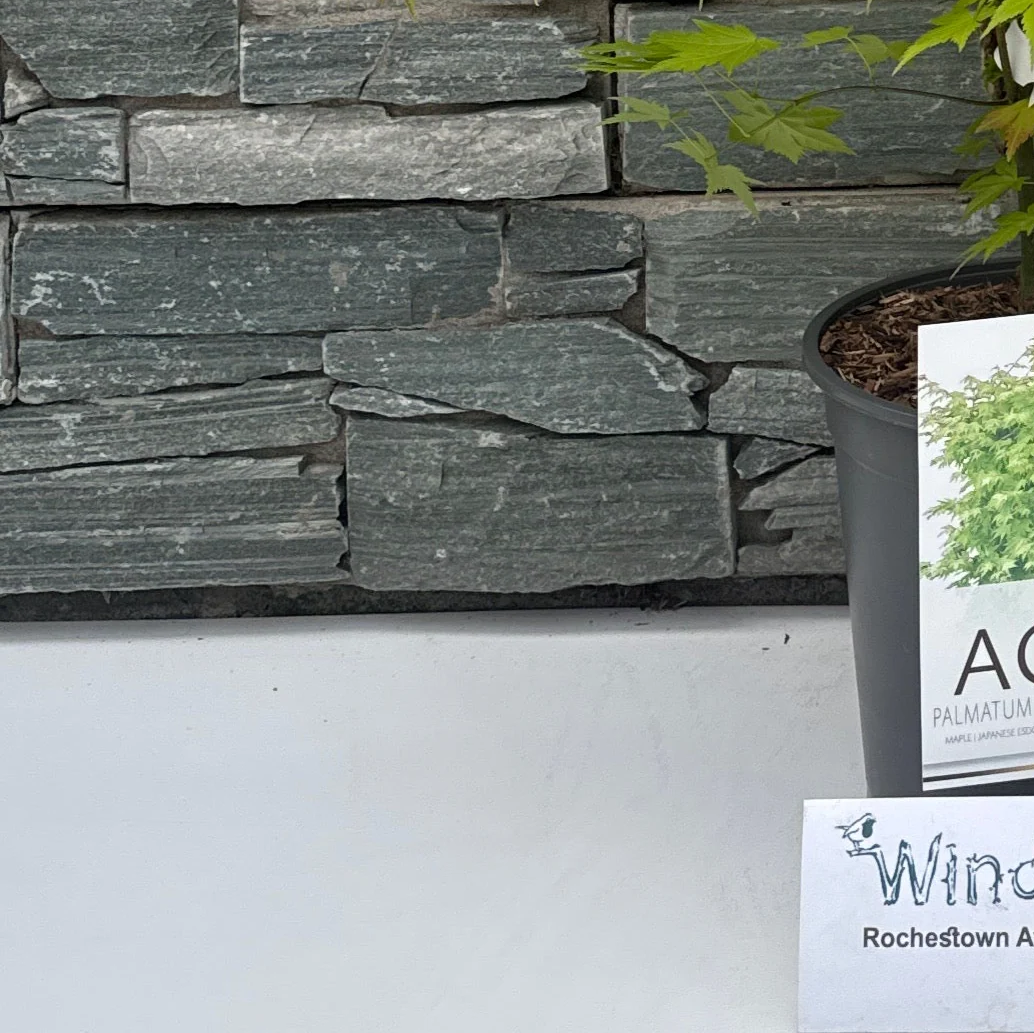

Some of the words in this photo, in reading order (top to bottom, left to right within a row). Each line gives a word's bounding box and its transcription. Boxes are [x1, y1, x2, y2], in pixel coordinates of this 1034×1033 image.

[933, 696, 1033, 728] PALMATUM
[945, 732, 972, 745] MAPLE
[977, 727, 1016, 742] JAPANESE
[863, 926, 1009, 949] Rochestown
